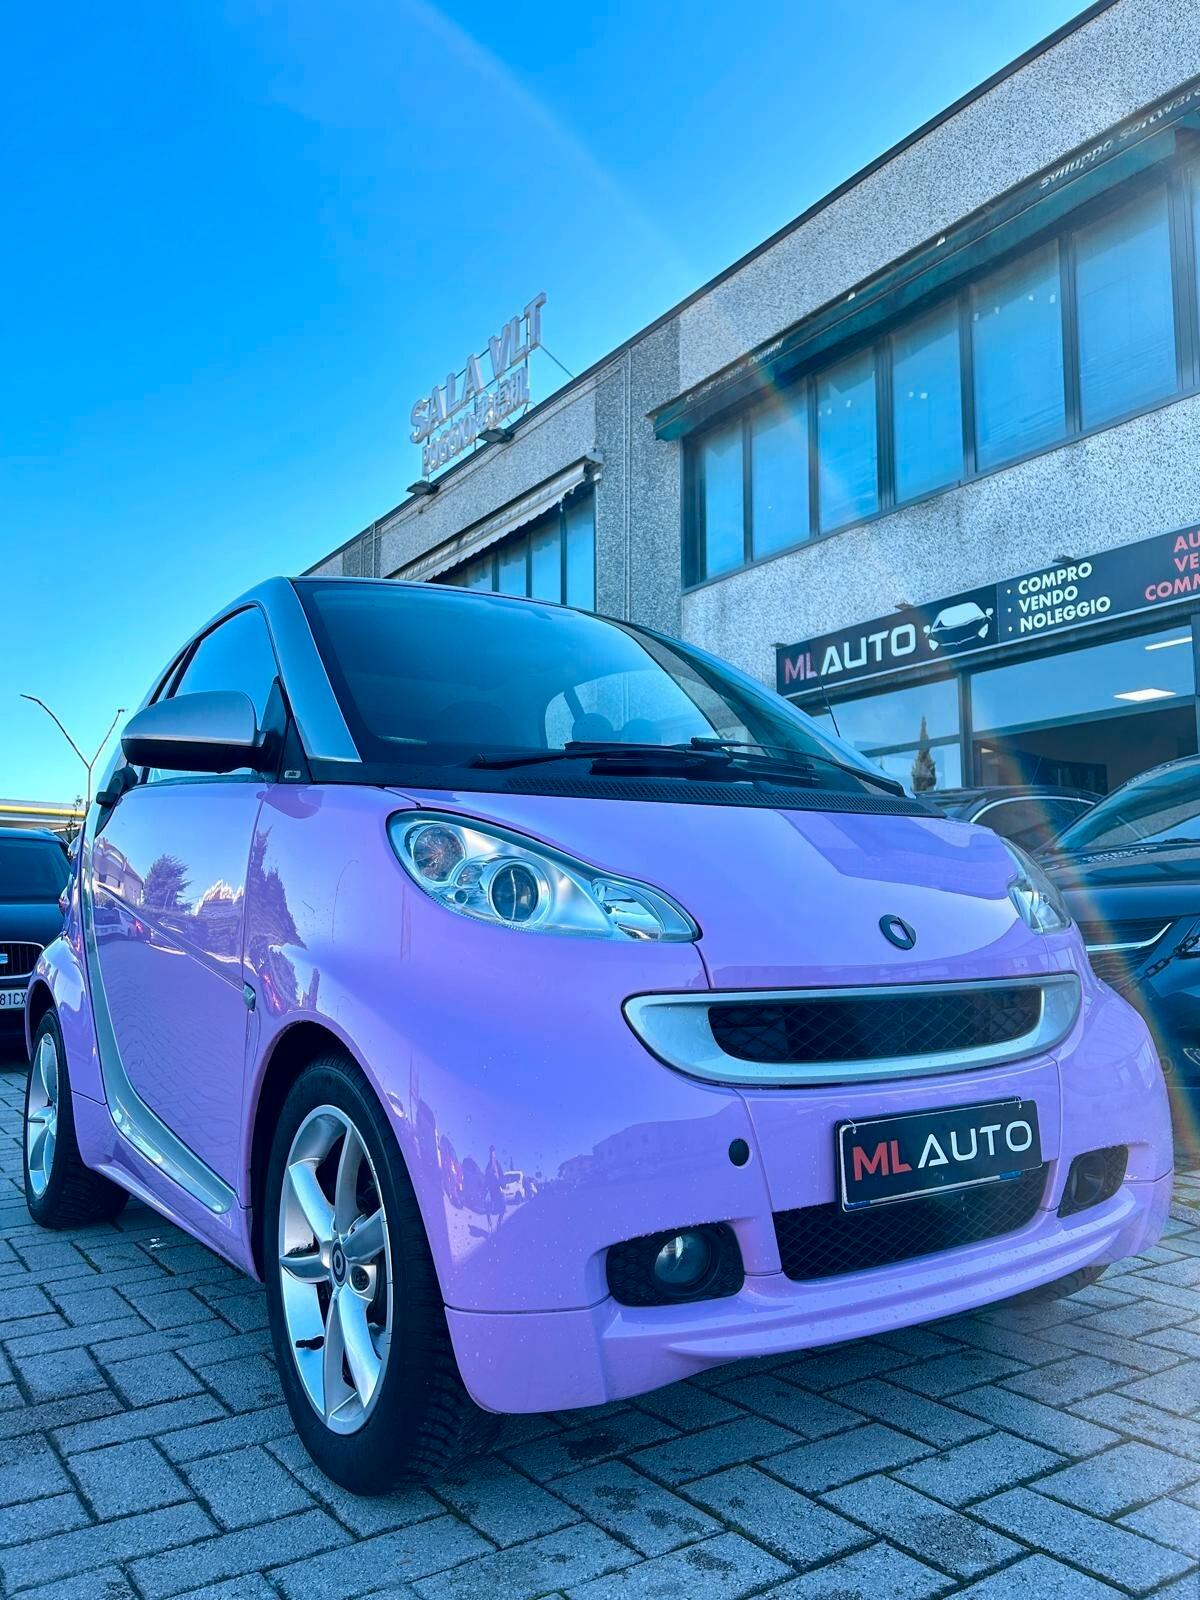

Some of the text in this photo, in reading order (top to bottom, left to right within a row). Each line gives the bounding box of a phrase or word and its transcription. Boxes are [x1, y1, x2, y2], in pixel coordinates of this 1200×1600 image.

[410, 353, 484, 444] SALA
[488, 292, 547, 380] VLT
[1018, 561, 1093, 595] COMPRO
[1174, 552, 1200, 573] VE
[1018, 585, 1078, 613] VENDO
[1019, 596, 1111, 633] NOLEGGIO
[784, 623, 916, 684] ML AUTO
[852, 1120, 1033, 1182] ML AUTO
